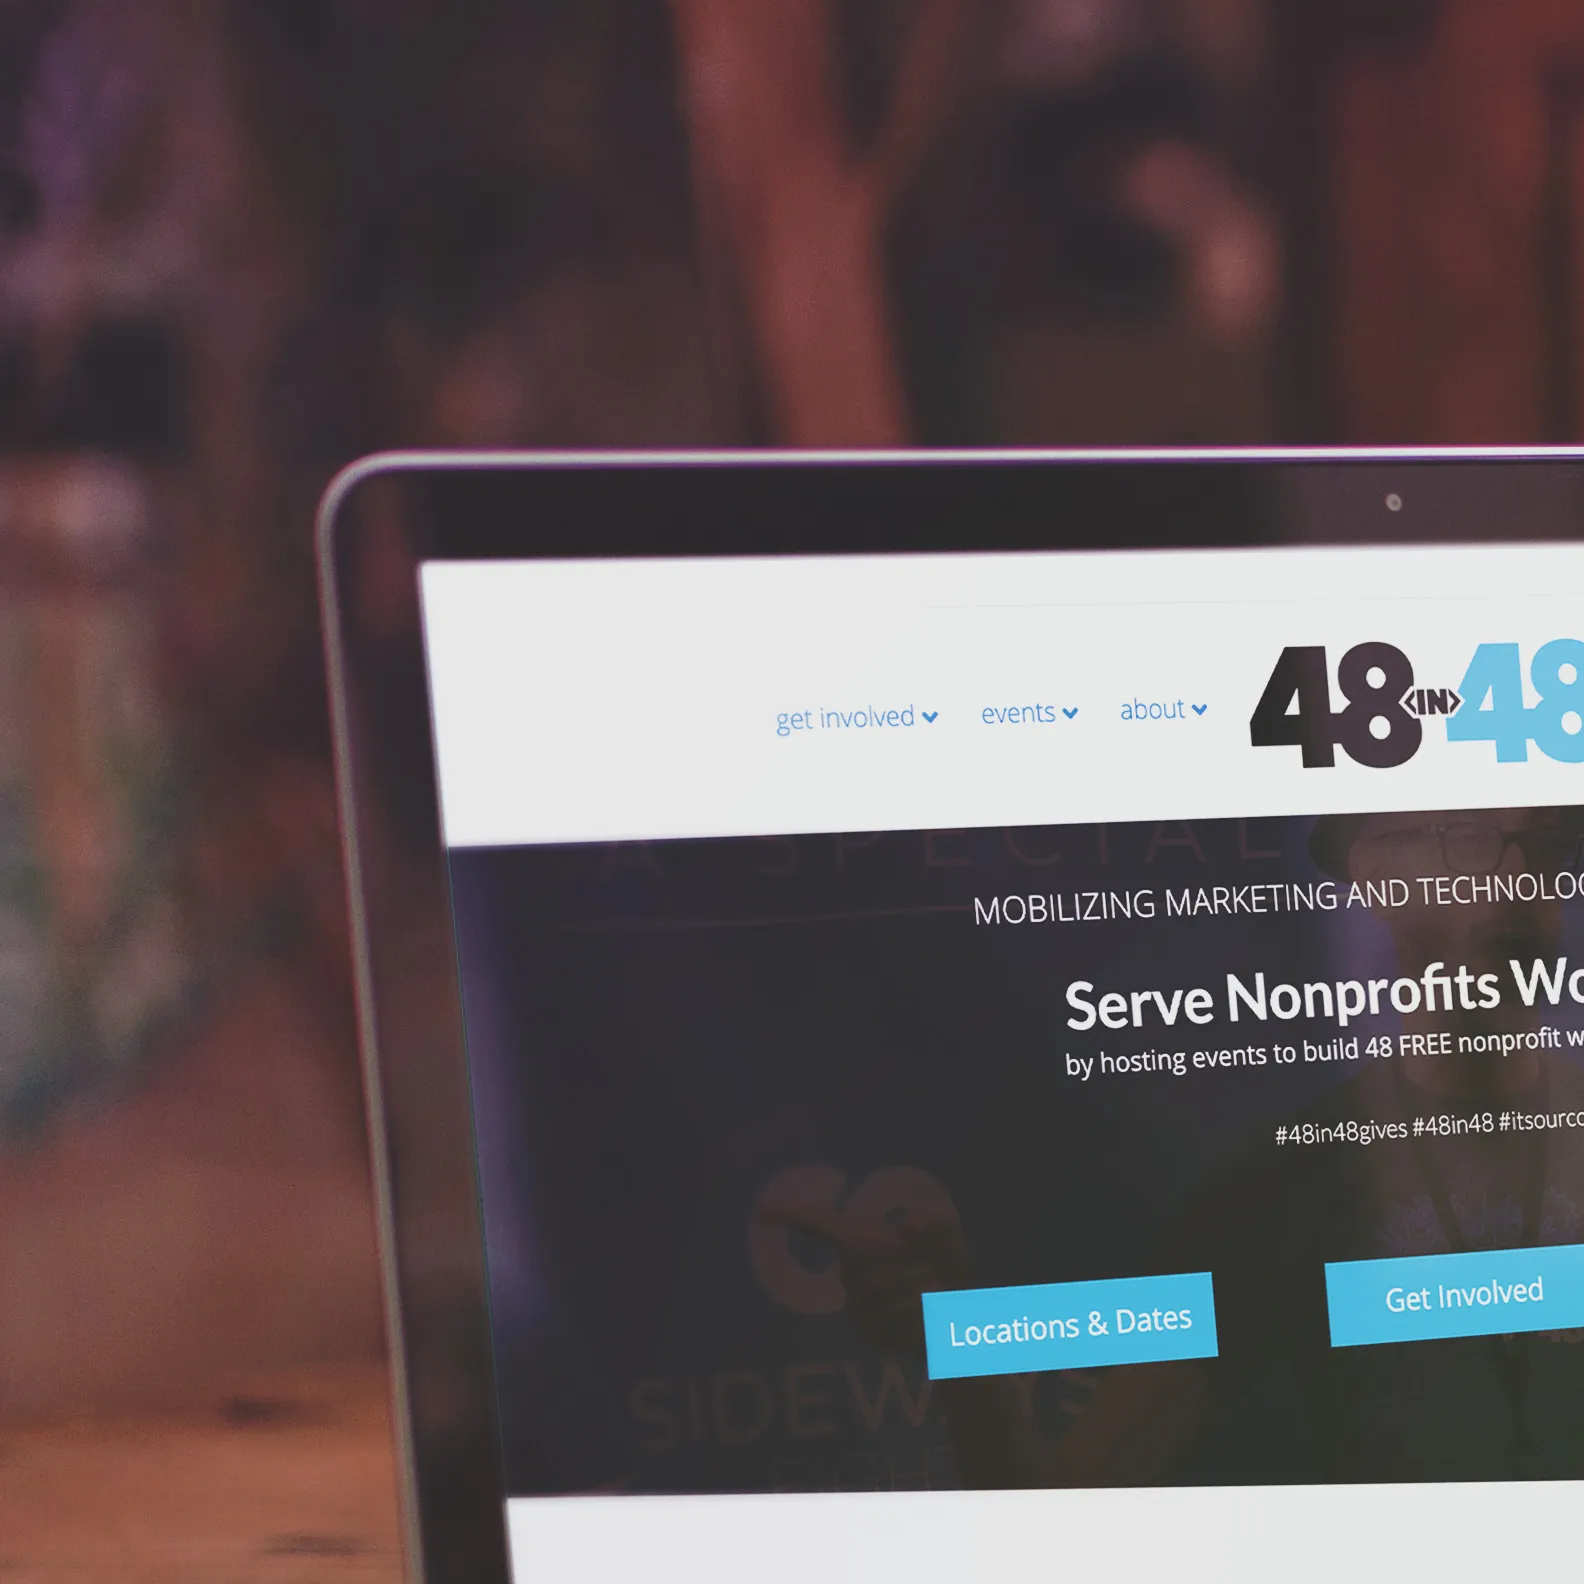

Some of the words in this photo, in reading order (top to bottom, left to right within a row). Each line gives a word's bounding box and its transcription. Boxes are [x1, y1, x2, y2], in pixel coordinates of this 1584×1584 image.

[777, 710, 813, 736] get
[821, 704, 914, 728] involved
[982, 704, 1056, 724] events
[1121, 698, 1185, 720] about
[975, 890, 1155, 925] MOBILIZING
[1166, 882, 1337, 916] MARKETING
[1347, 879, 1409, 908] AND
[1066, 981, 1213, 1030] Serve
[1227, 962, 1500, 1026] Nonprofits
[1066, 1053, 1093, 1081] by
[1101, 1049, 1186, 1075] hosting
[1193, 1046, 1267, 1068] events
[1273, 1045, 1296, 1063] to
[1304, 1037, 1358, 1061] build
[1365, 1036, 1392, 1057] 48
[1399, 1033, 1452, 1056] FREE
[1459, 1026, 1561, 1056] nonprofit
[1276, 1120, 1408, 1145] #48in48gives
[1413, 1113, 1494, 1136] #48in48
[1386, 1288, 1431, 1312] Get
[1439, 1276, 1543, 1308] Involved
[950, 1316, 1079, 1346] Locations
[1088, 1311, 1109, 1336] &
[1116, 1309, 1192, 1333] Dates
